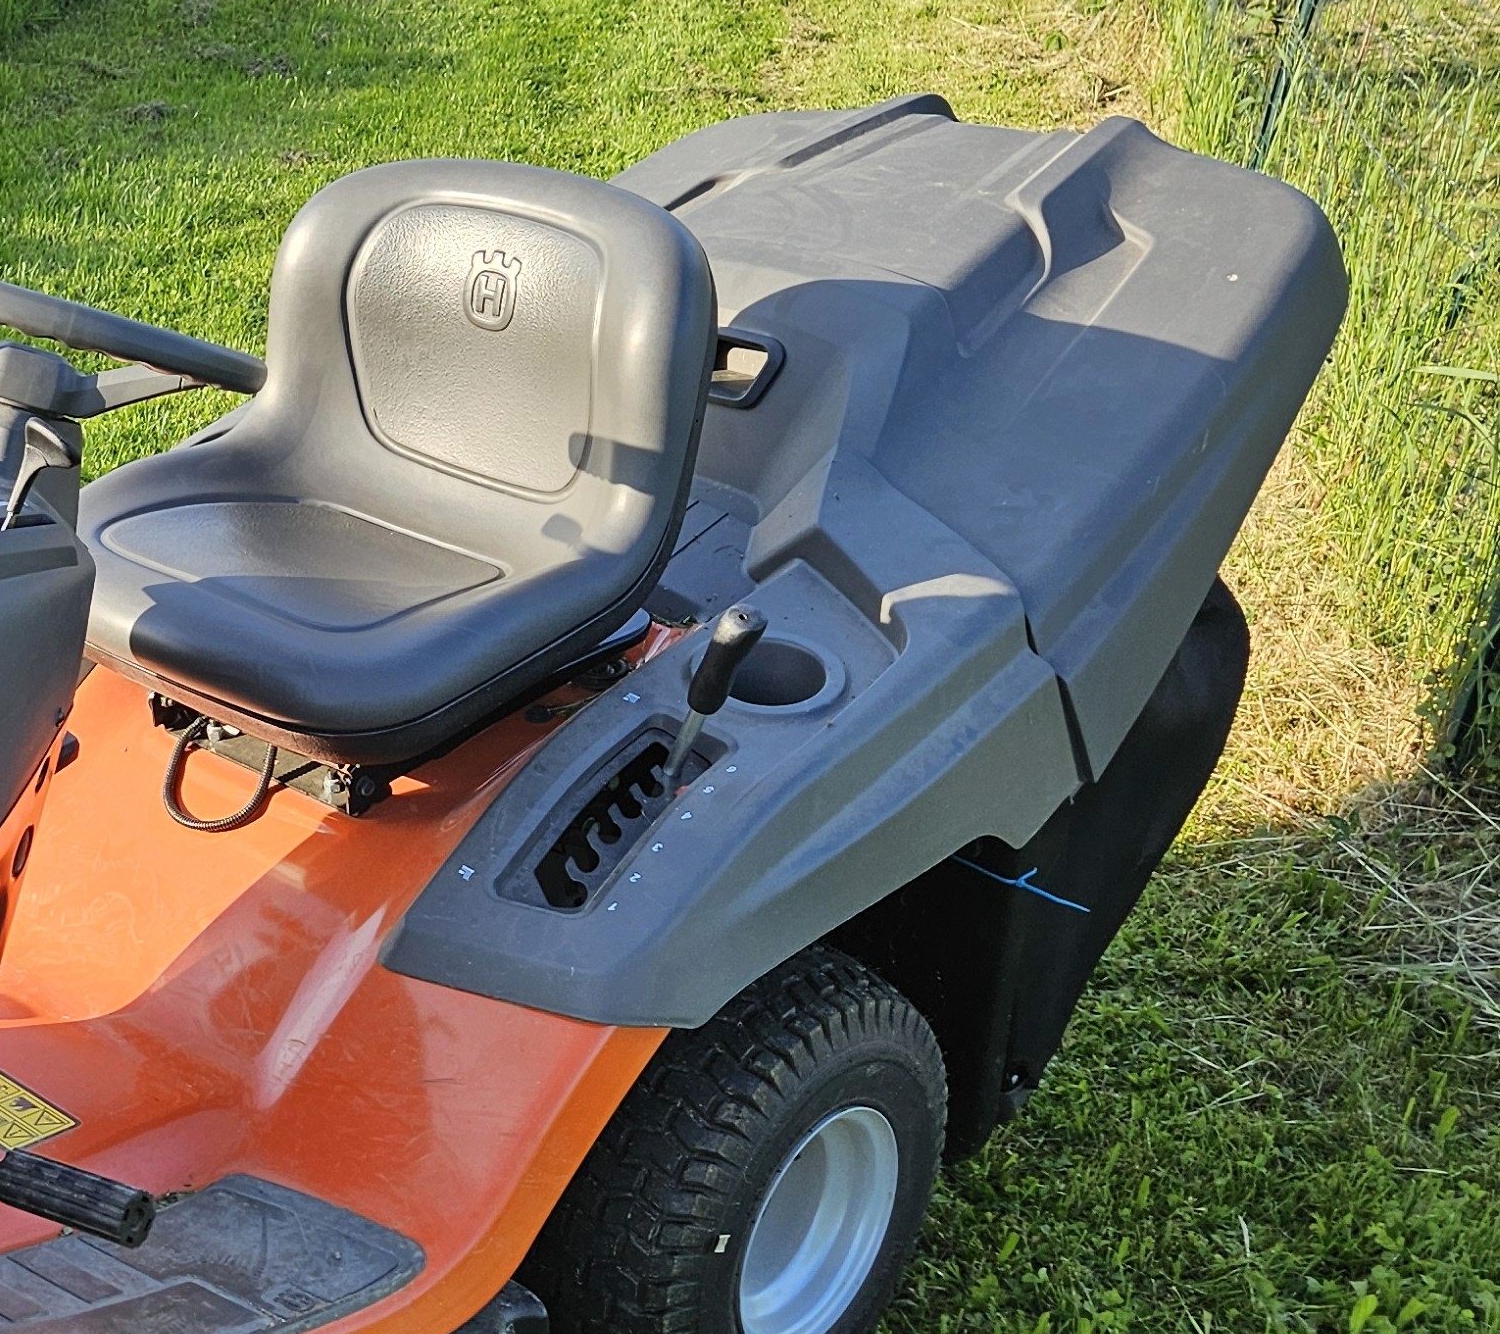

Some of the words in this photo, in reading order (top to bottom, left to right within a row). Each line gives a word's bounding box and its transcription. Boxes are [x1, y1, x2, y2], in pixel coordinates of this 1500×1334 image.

[703, 786, 715, 794] 5
[681, 811, 693, 820] 4
[652, 842, 664, 852] 3
[629, 872, 642, 883] 2
[607, 902, 618, 911] 1
